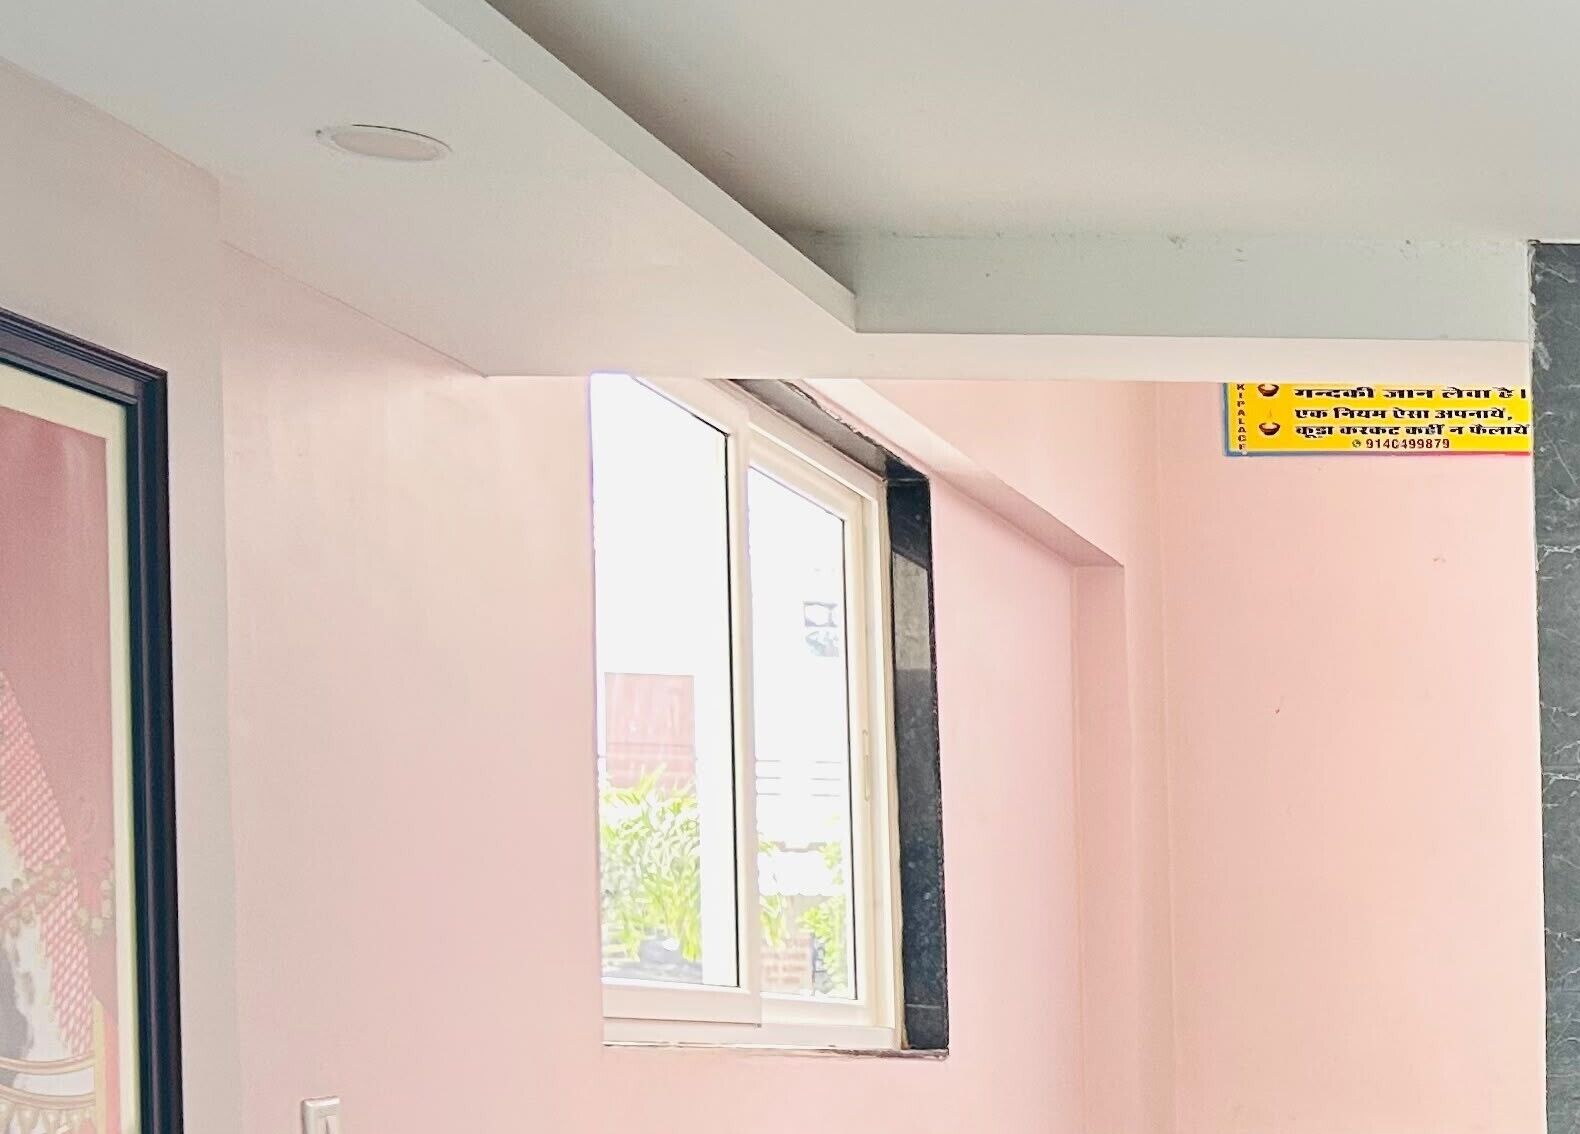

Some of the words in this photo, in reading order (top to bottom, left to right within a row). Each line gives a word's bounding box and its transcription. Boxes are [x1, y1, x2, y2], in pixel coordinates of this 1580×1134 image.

[1383, 389, 1434, 398] जान
[1442, 387, 1491, 398] लेवा
[1294, 409, 1328, 419] एक
[1333, 407, 1387, 419] नियम
[1392, 407, 1429, 419] ऐसा
[1340, 426, 1401, 435] करकट
[1405, 423, 1445, 435] कहीं
[1450, 426, 1464, 435] न
